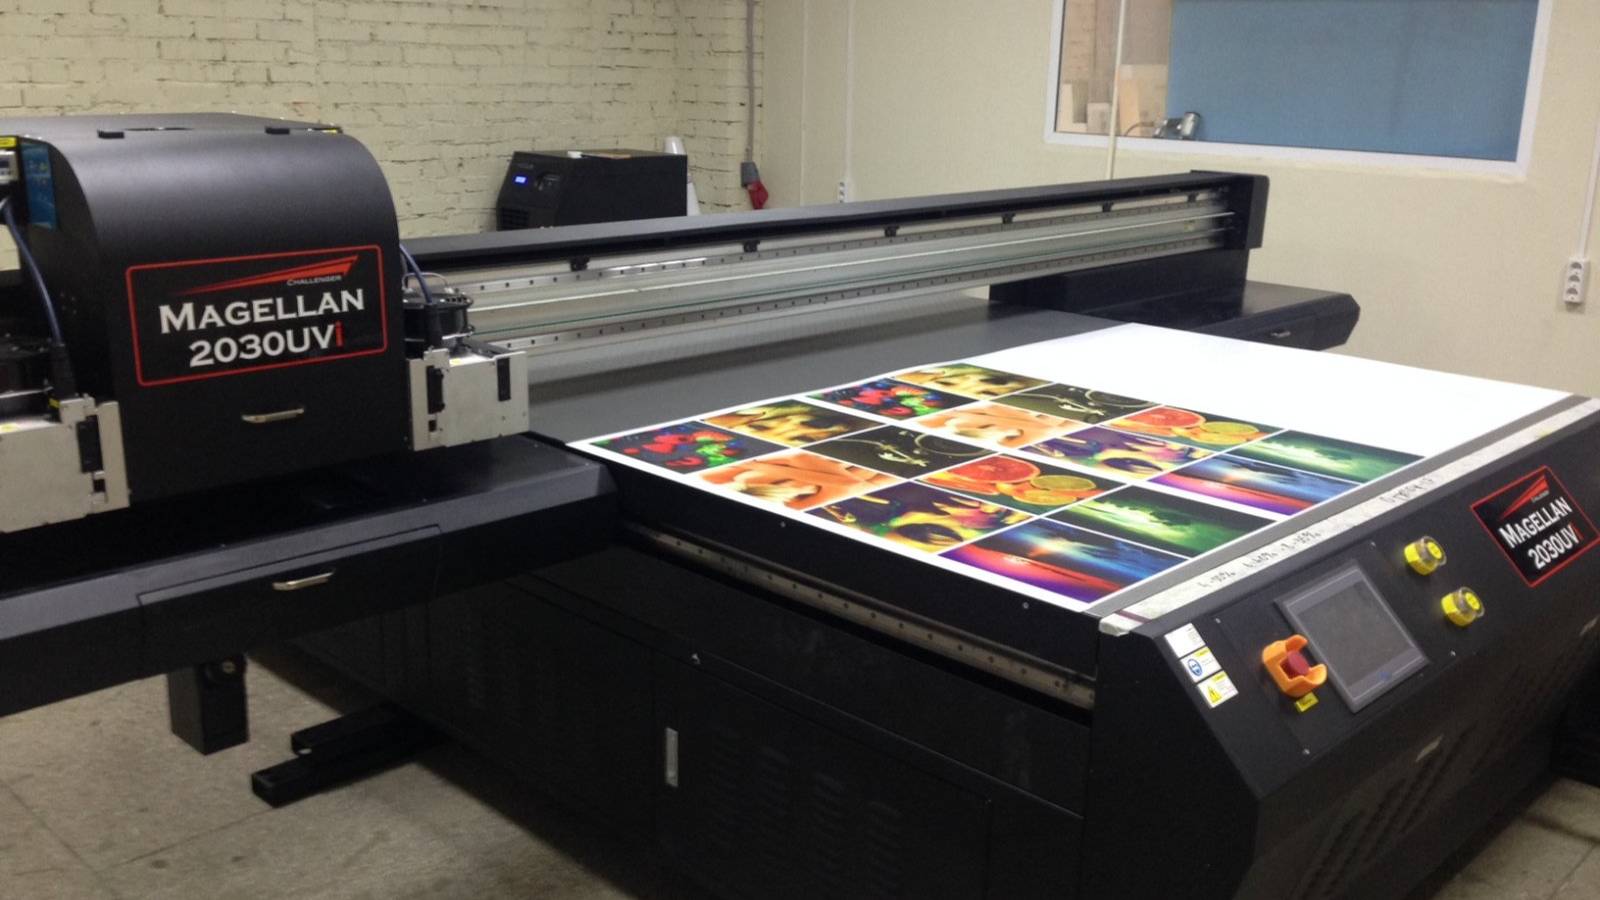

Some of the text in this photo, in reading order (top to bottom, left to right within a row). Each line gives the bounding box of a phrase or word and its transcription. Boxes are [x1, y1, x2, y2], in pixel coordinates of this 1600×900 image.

[158, 288, 365, 334] MAGELLAN
[189, 321, 345, 368] 2030UVi
[1498, 496, 1573, 549] MAGELLAN
